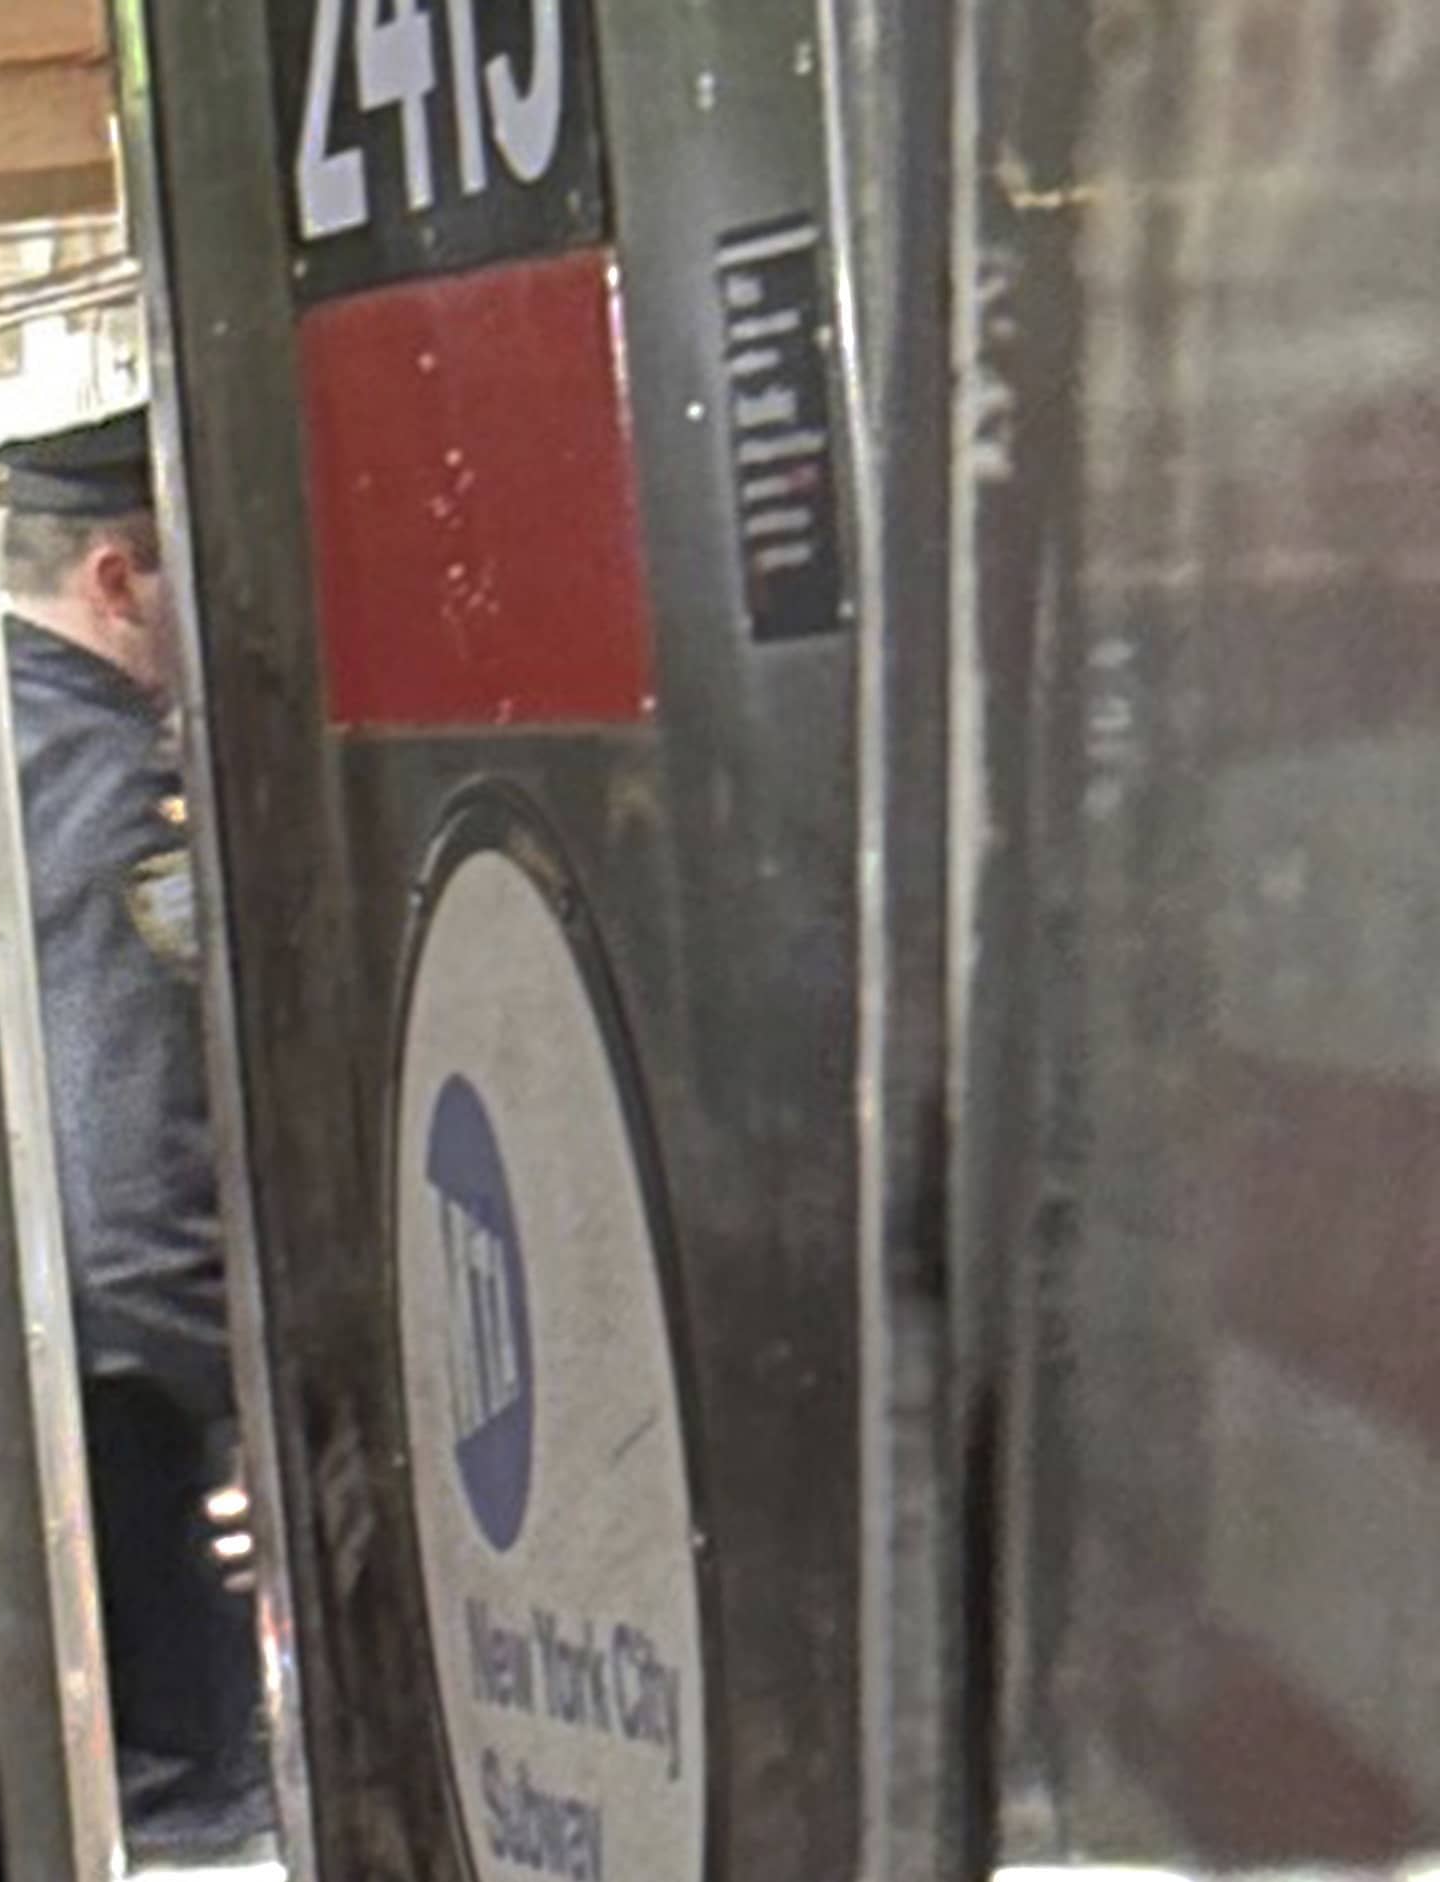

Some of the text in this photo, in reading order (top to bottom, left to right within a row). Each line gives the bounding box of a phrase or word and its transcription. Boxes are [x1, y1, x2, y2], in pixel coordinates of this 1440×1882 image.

[466, 1597, 680, 1783] New York City
